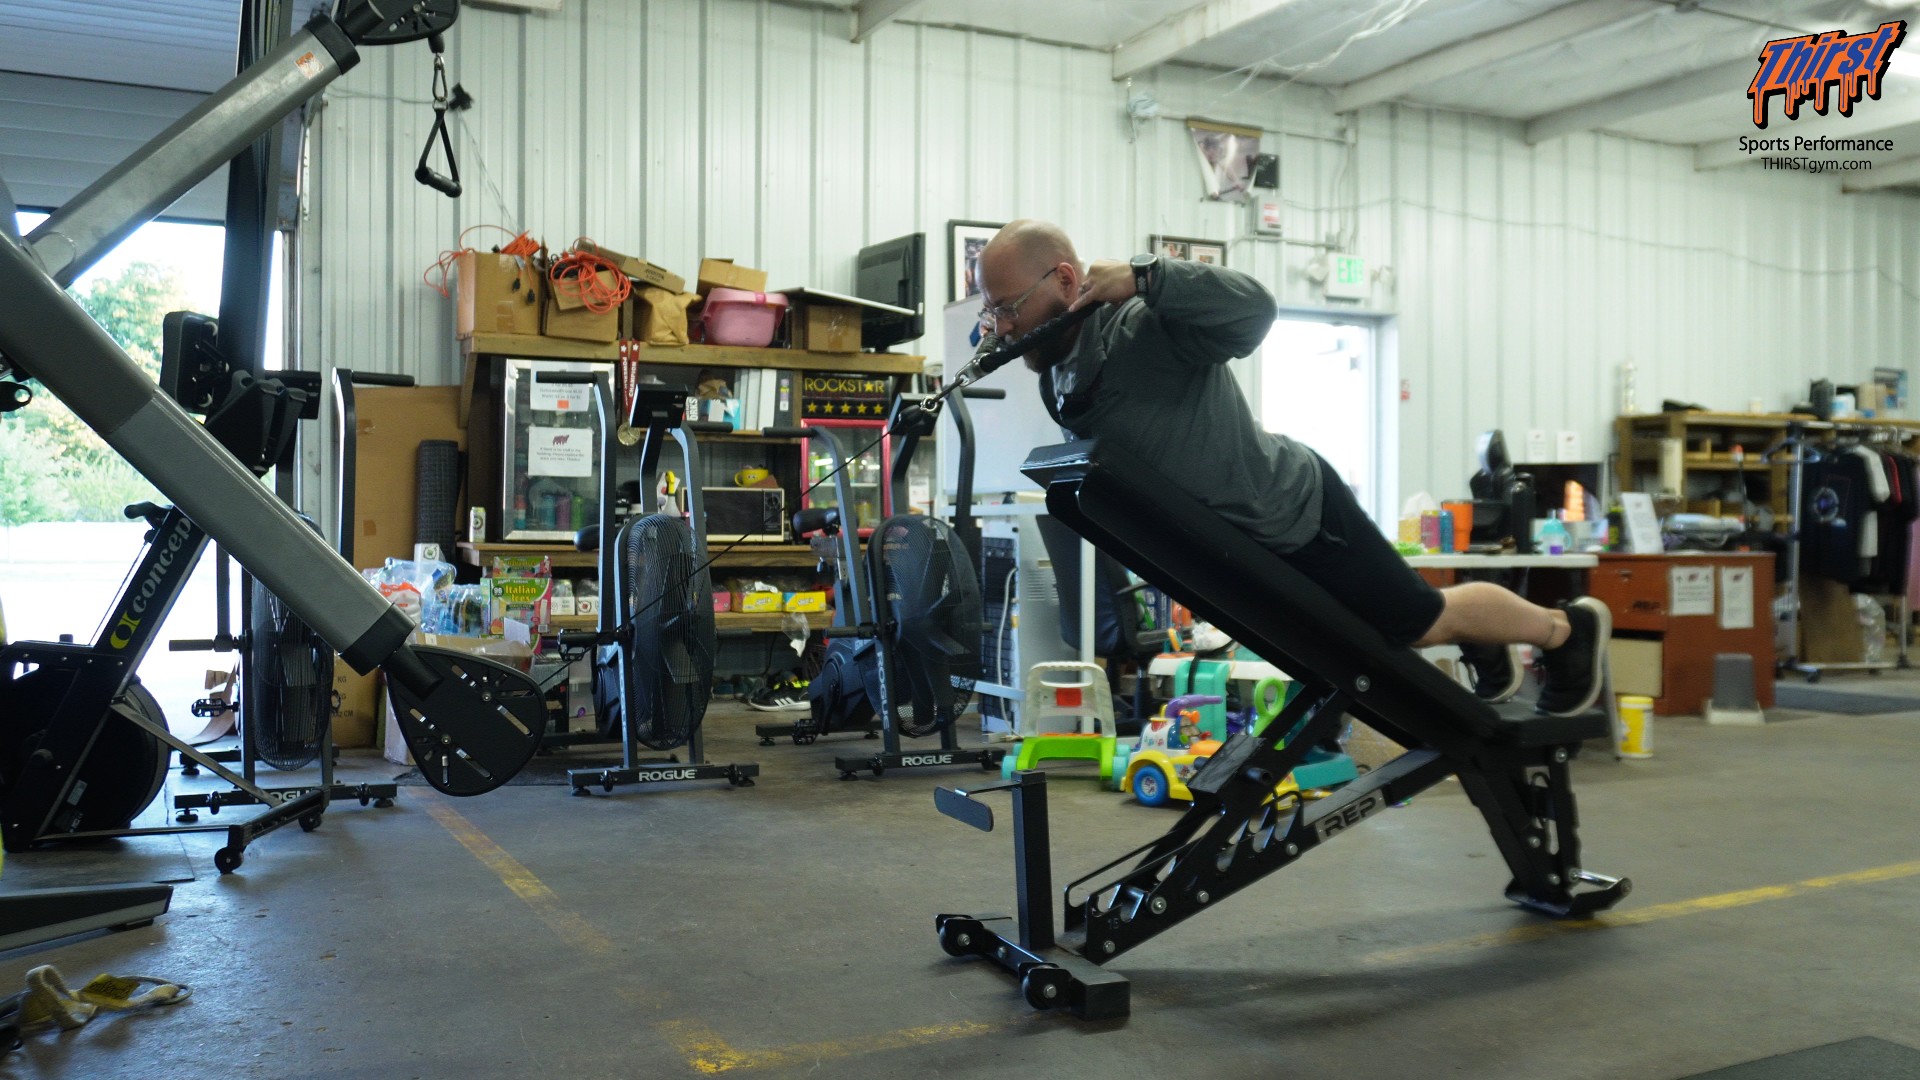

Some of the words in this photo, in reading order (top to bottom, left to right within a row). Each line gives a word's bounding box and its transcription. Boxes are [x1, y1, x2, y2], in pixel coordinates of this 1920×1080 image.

[628, 361, 637, 397] CHAMPION
[132, 517, 192, 613] concep
[505, 585, 537, 594] Italian
[902, 754, 952, 767] ROGUE
[638, 769, 697, 782] ROGUE
[1324, 796, 1377, 837] REP
